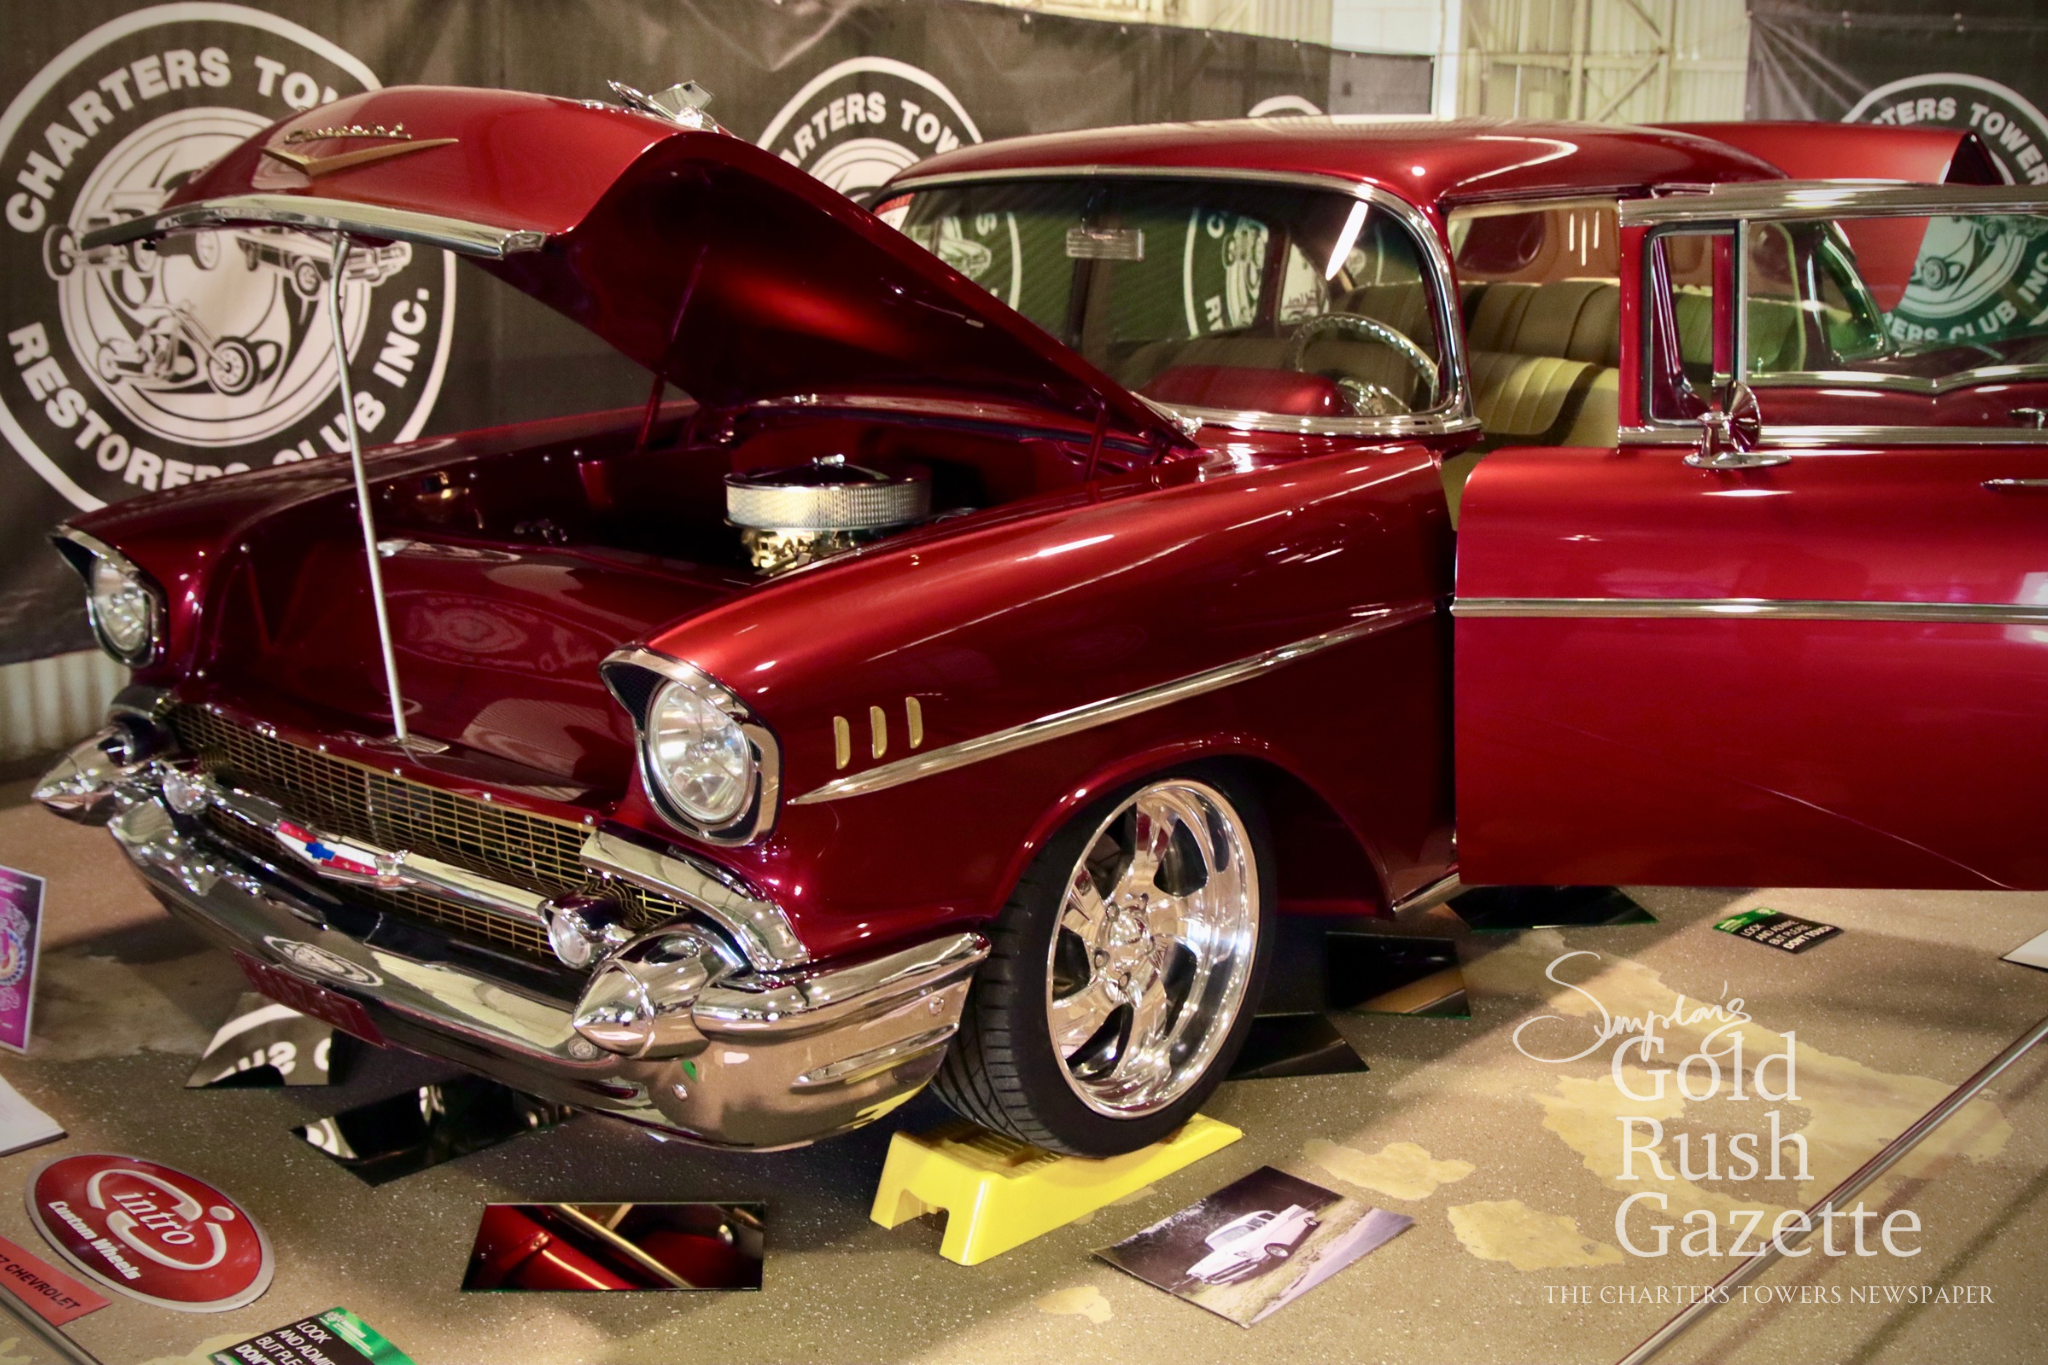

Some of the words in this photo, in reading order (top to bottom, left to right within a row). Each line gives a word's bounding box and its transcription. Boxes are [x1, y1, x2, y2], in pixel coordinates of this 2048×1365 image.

[5, 46, 232, 233] CHARTERS
[780, 91, 887, 168] ARTERS
[1872, 96, 1957, 125] TERS
[1969, 102, 2048, 185] TOWER
[372, 287, 430, 389] INC.
[47, 1200, 98, 1240] Custom
[90, 1238, 142, 1280] Wheels
[111, 1191, 195, 1245] intro
[5, 1263, 81, 1310] CHEVROLET
[255, 1336, 285, 1352] BUT
[274, 1350, 303, 1365] PLE
[275, 1329, 305, 1346] AND
[296, 1321, 332, 1344] LOOK
